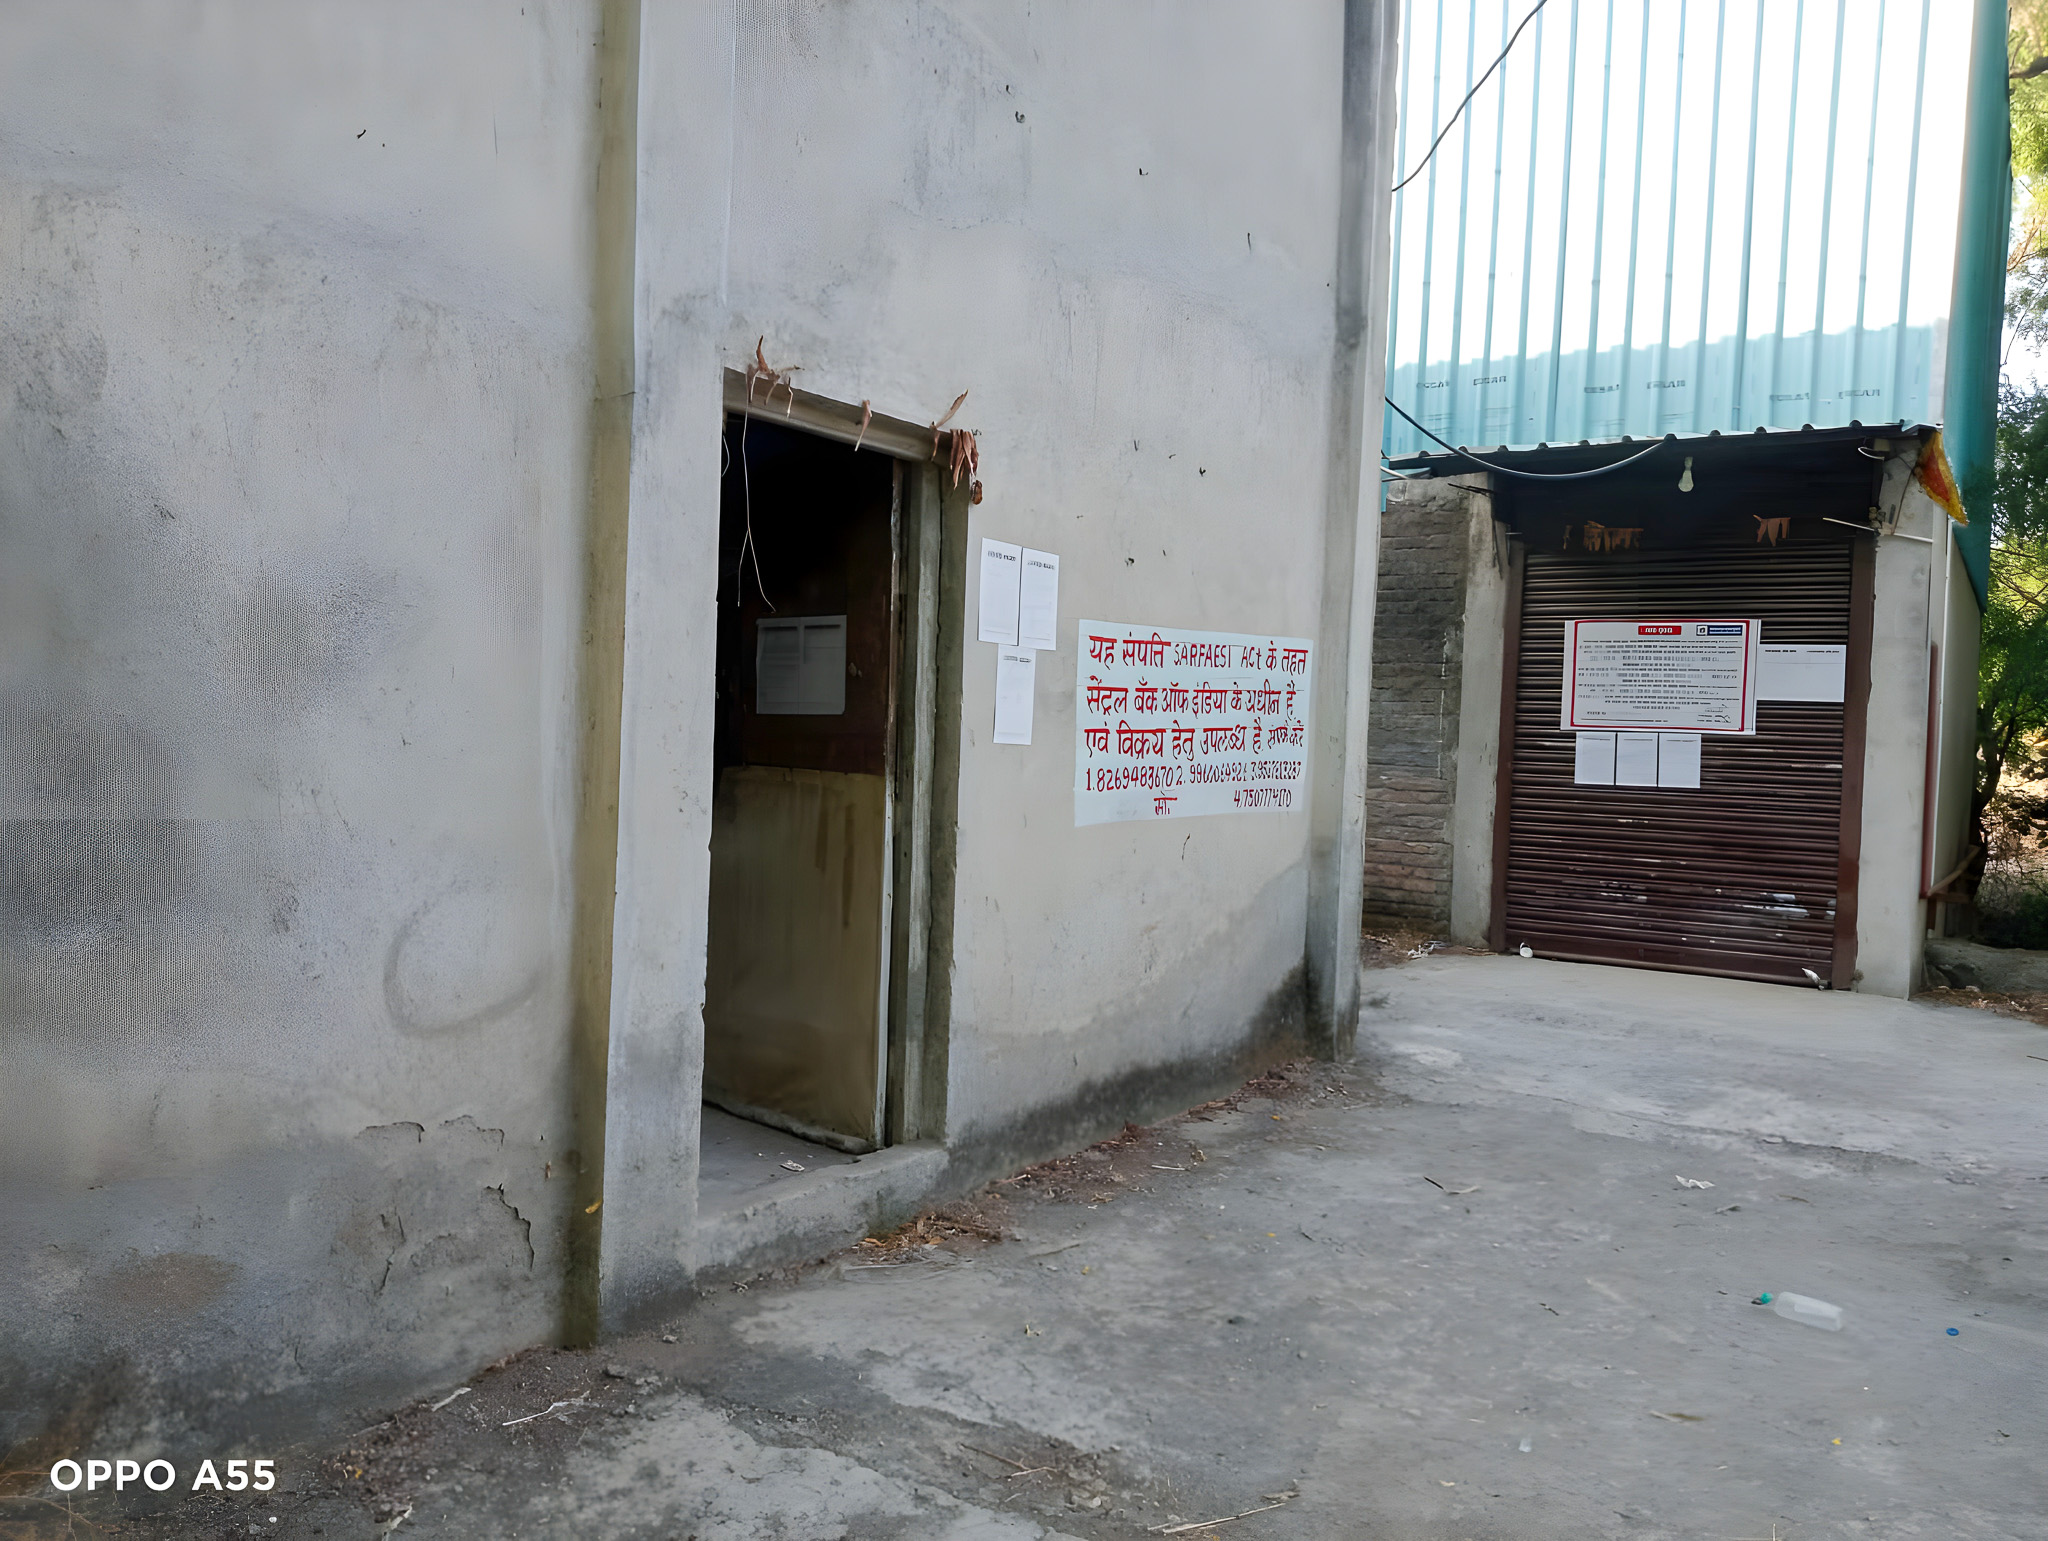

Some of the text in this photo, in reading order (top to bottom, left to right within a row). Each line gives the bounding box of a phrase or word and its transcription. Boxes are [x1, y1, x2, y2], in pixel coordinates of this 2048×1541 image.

[1089, 635, 1117, 670] यह
[1281, 648, 1309, 676] तहत
[1084, 721, 1111, 758] एवं
[1116, 719, 1167, 760] विक्रय
[1171, 719, 1196, 762] हेतु
